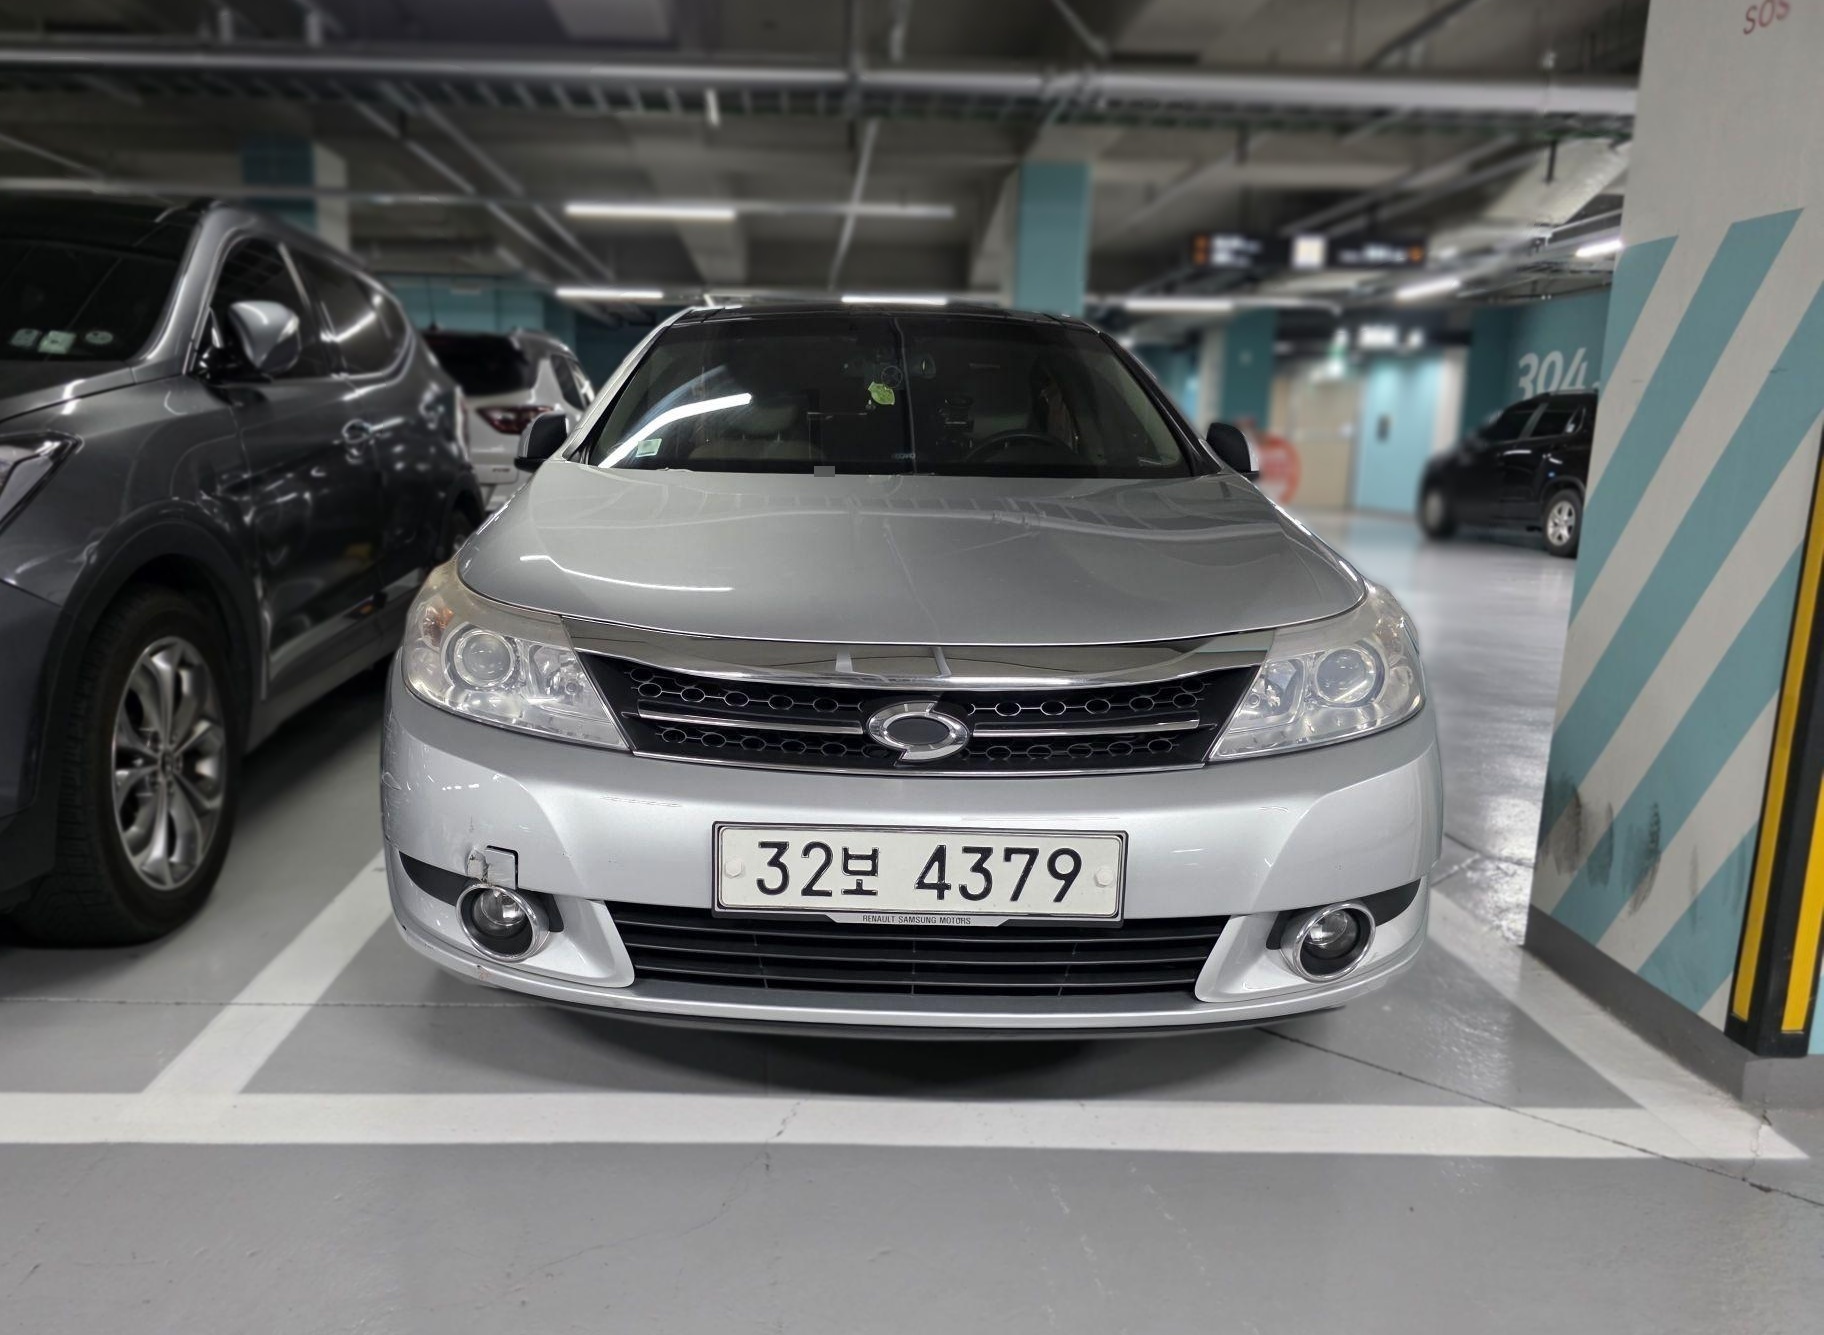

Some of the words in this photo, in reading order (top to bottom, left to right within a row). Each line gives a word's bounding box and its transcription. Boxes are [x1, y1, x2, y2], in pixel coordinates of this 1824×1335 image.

[1743, 0, 1790, 35] SOS
[1518, 347, 1588, 401] 304
[755, 840, 879, 897] 32보
[914, 844, 1083, 903] 4379
[862, 914, 896, 923] RENAULT
[898, 915, 937, 924] SAMSUNG
[939, 916, 971, 925] MOTORS
